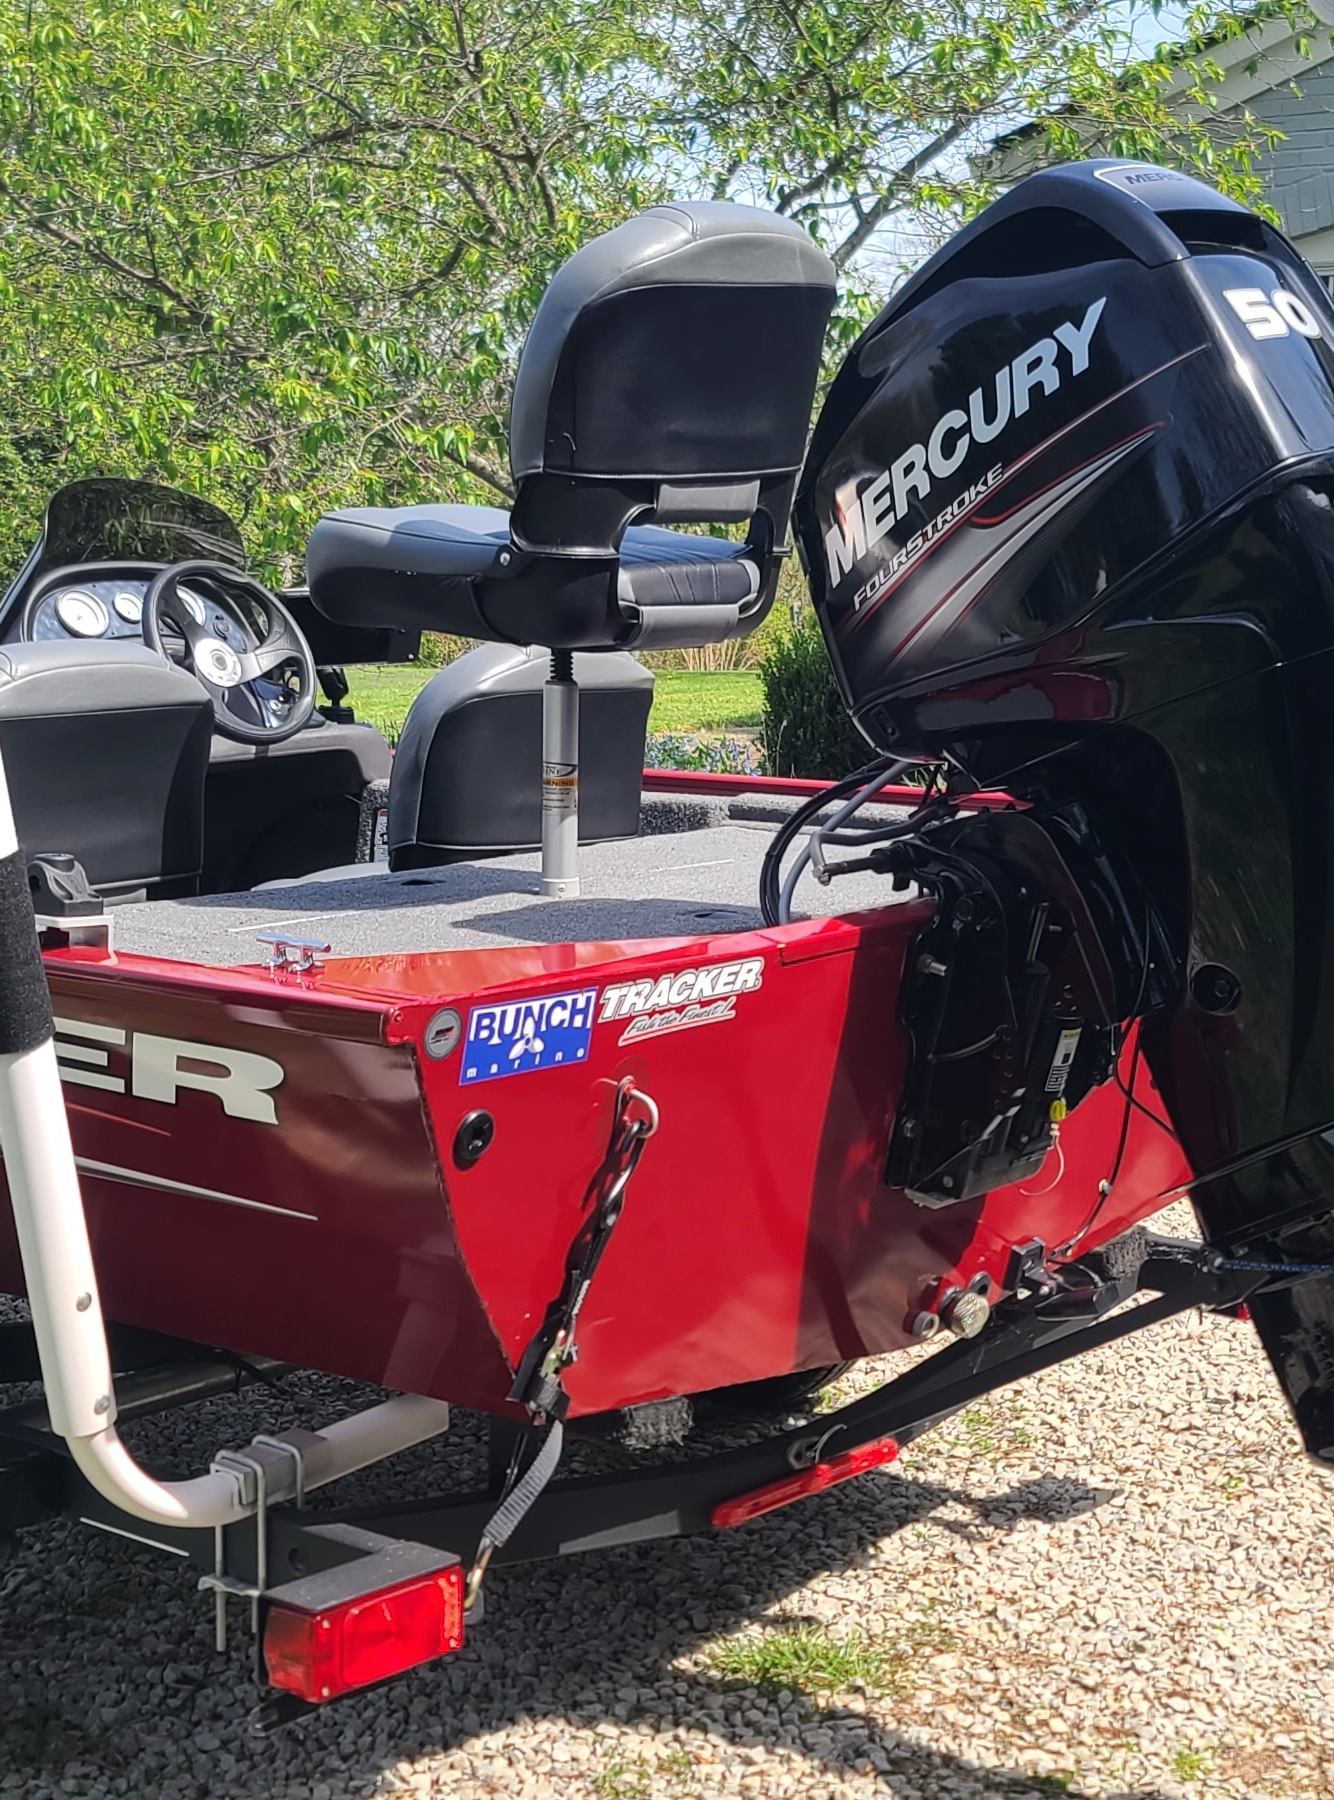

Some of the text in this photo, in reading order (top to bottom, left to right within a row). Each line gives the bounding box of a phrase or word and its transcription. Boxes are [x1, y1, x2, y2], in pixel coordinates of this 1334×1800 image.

[1223, 287, 1322, 341] 50
[824, 296, 1108, 589] MERCURY
[852, 462, 1005, 612] FOURSTROKE
[471, 996, 594, 1045] BUNCH
[599, 959, 764, 1021] TRACKER
